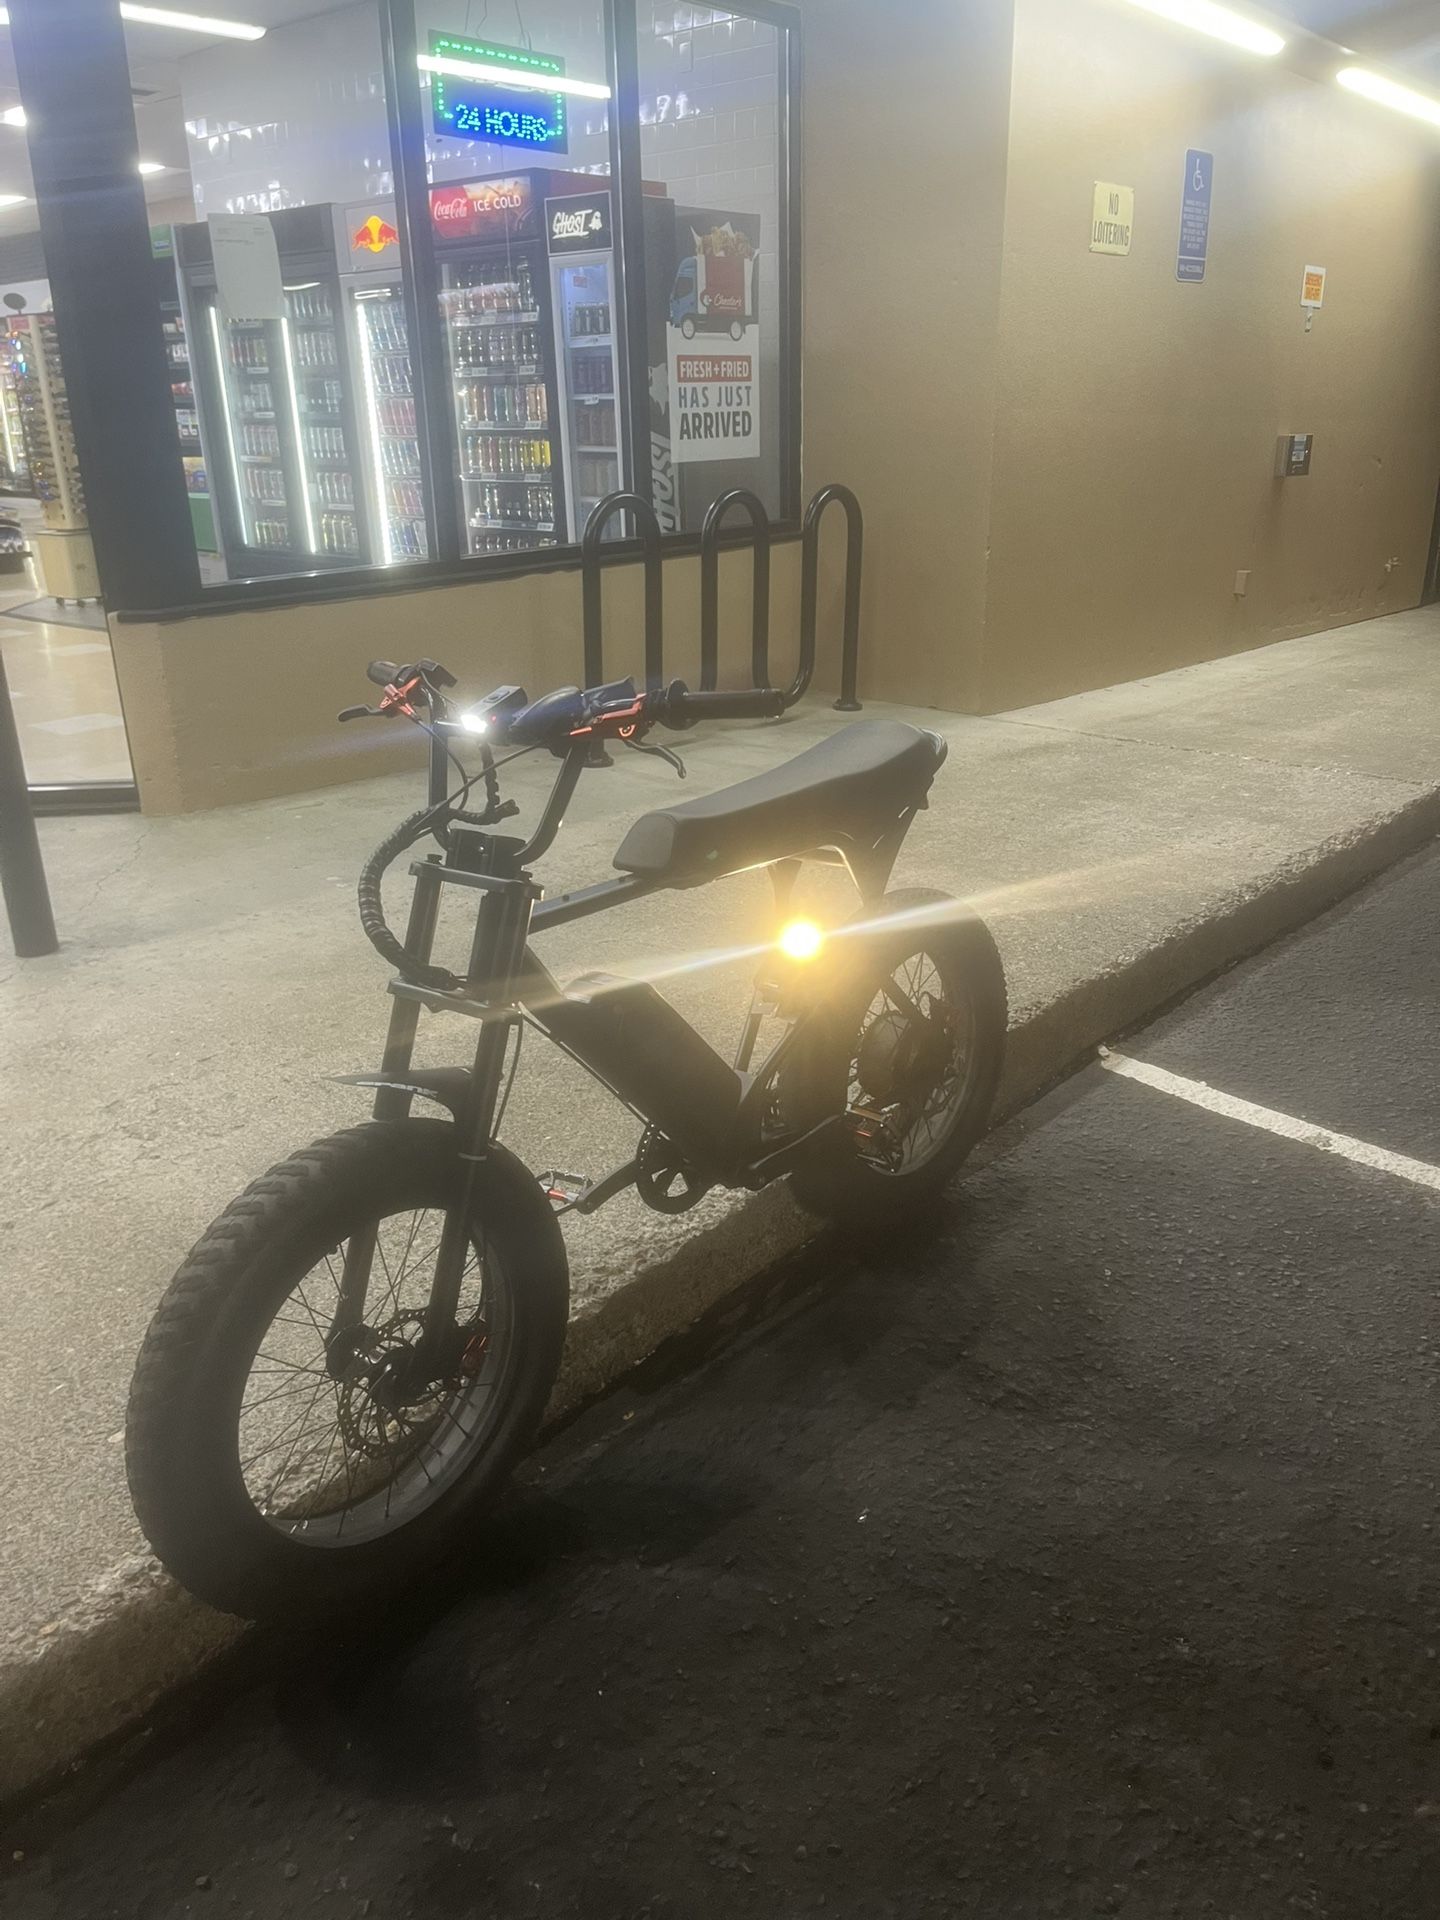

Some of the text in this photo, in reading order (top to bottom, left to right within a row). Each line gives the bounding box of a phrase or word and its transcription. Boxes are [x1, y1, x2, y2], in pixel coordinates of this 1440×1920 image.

[456, 104, 547, 142] 24 HOURS
[473, 195, 522, 213] ICE COLD
[1108, 192, 1119, 216] NO
[552, 209, 593, 237] GHOST
[1093, 220, 1130, 247] LOITERING
[678, 386, 752, 408] HAS JUST
[679, 410, 752, 440] ARRIVED
